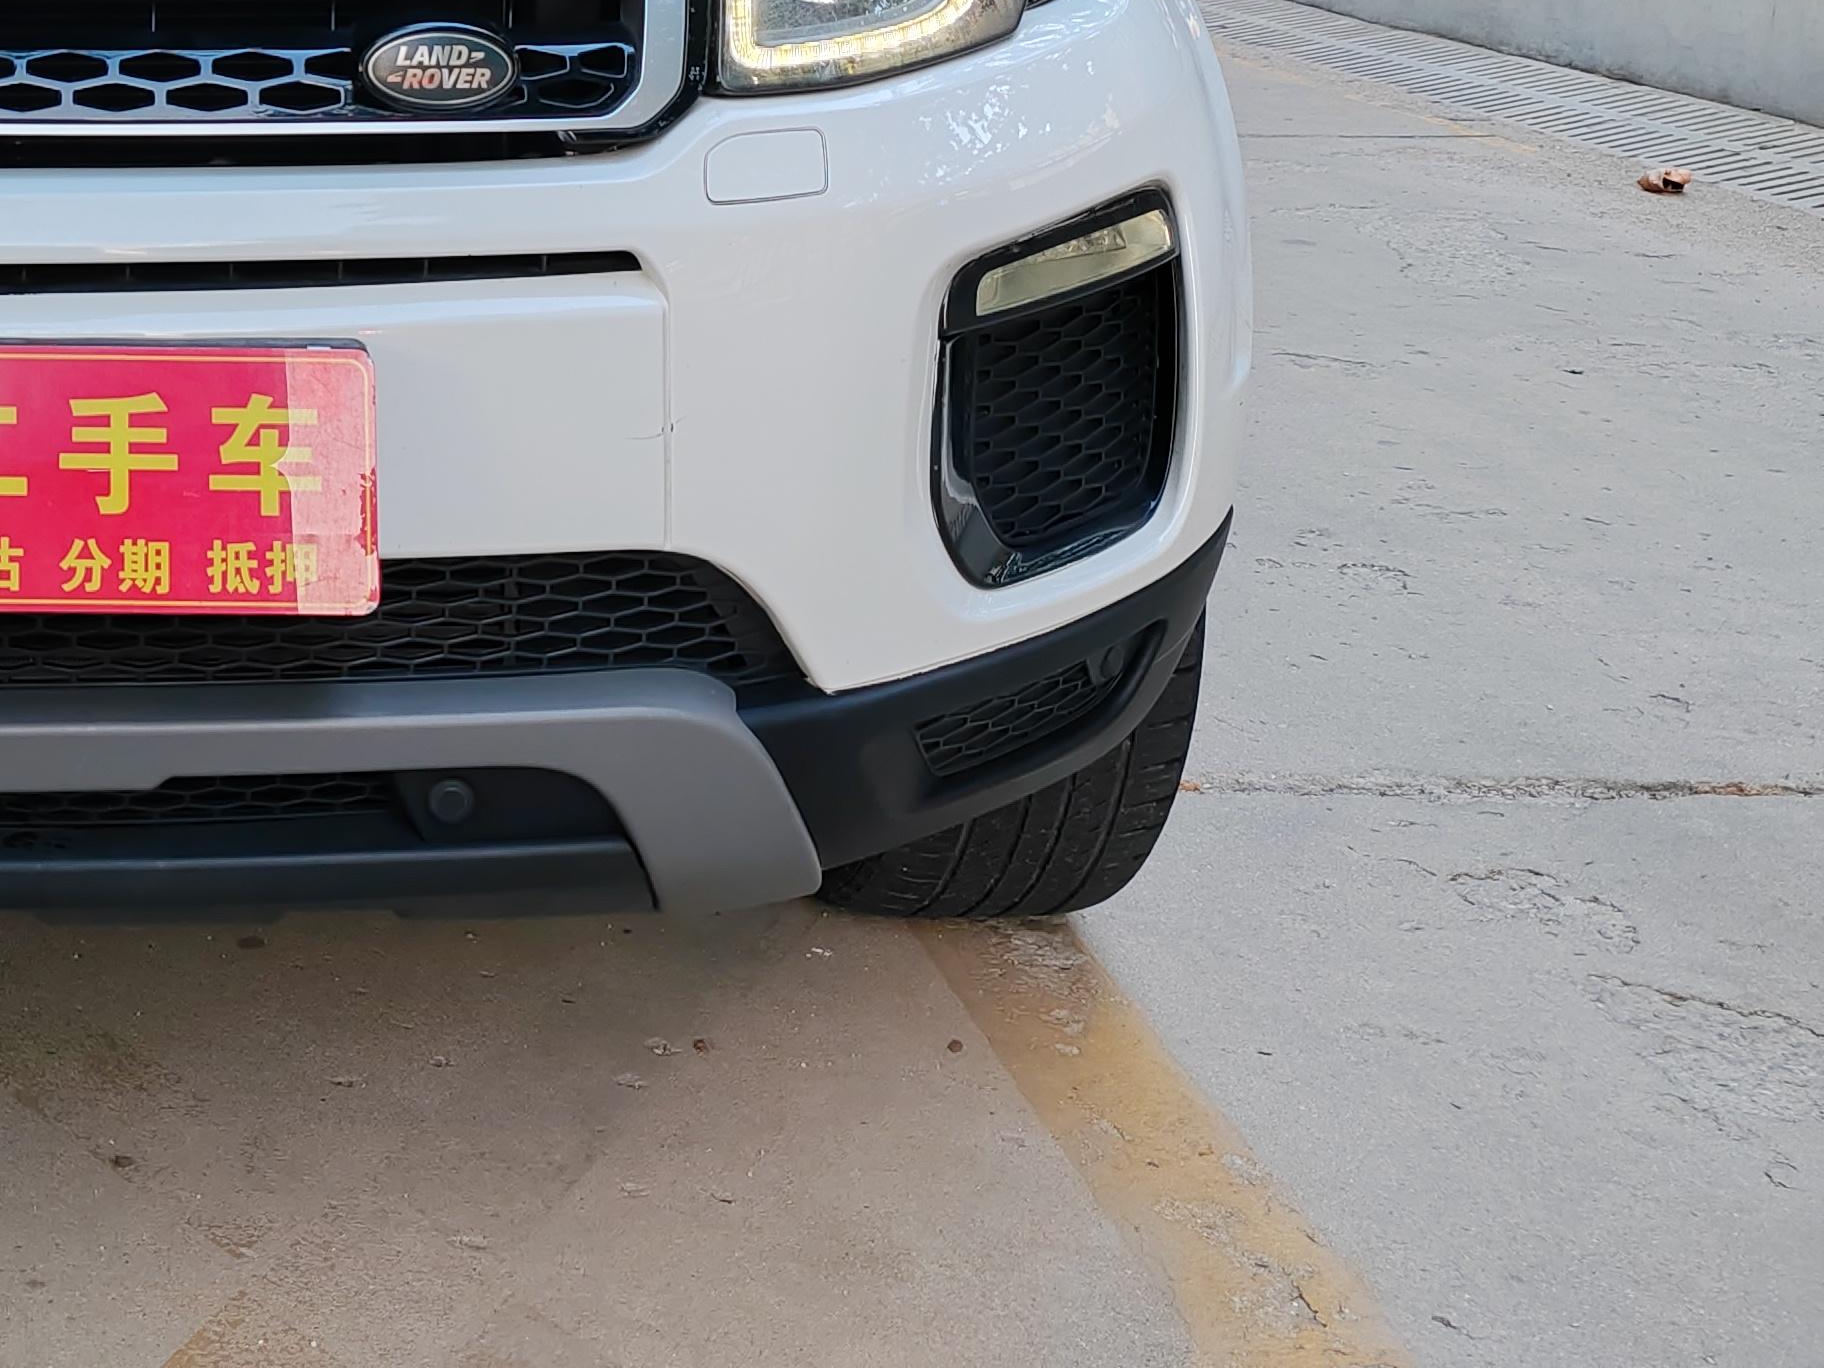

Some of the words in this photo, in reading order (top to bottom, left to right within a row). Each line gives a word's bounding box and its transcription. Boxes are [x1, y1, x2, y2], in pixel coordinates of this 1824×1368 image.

[396, 44, 469, 66] LAND
[402, 68, 491, 89] ROVER
[59, 537, 171, 594] 分期
[206, 539, 318, 596] 抵押
